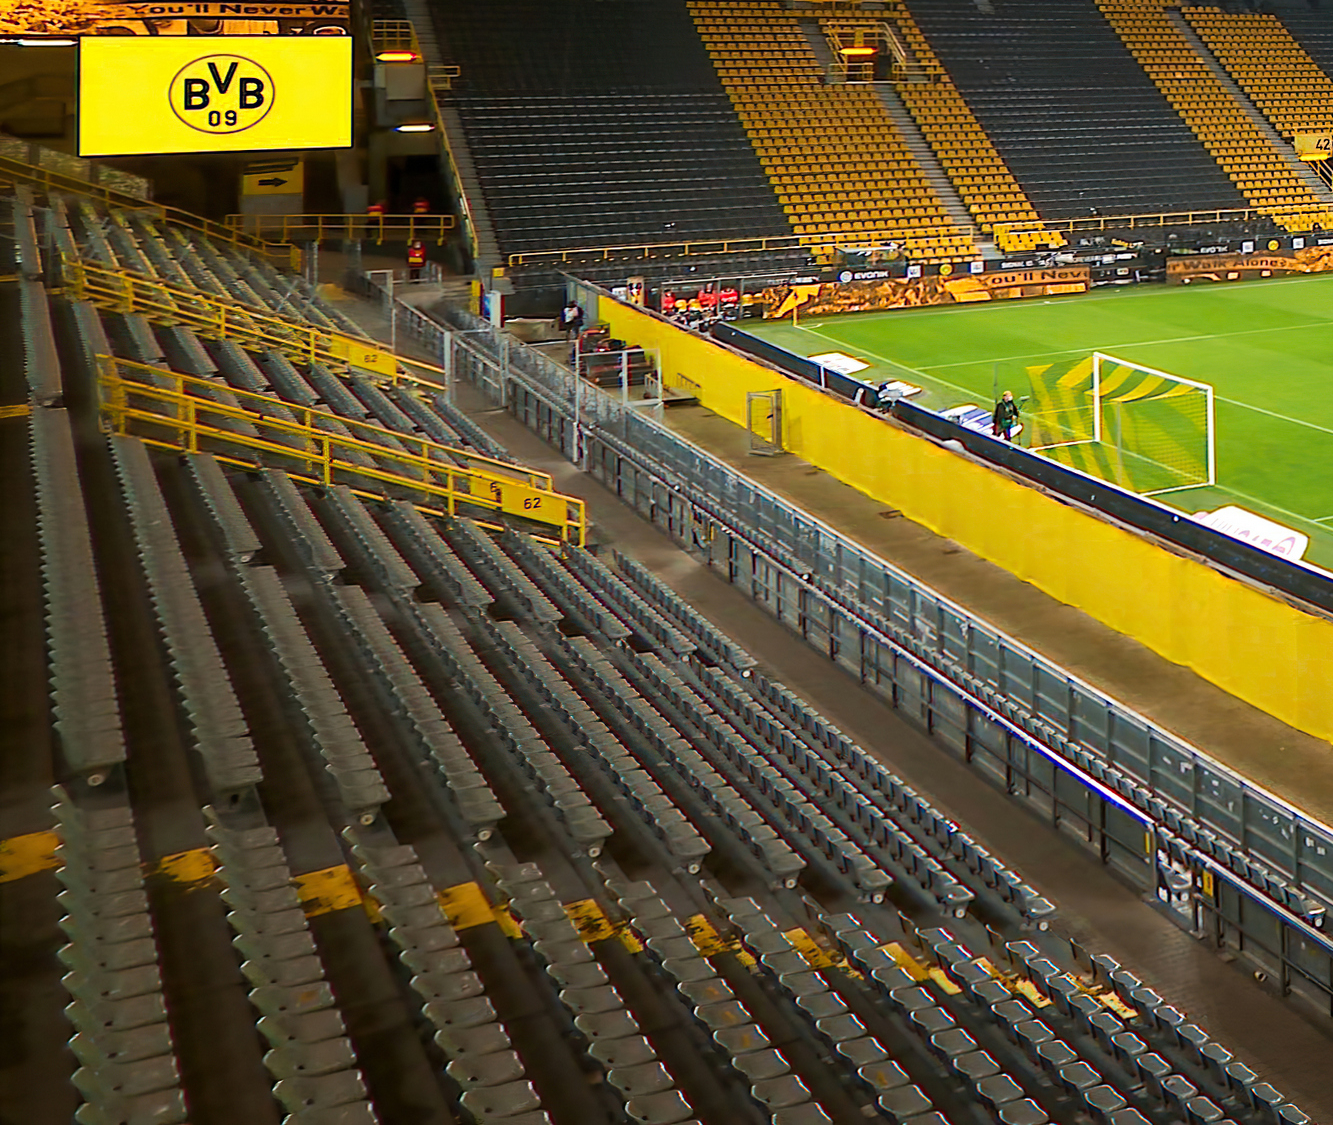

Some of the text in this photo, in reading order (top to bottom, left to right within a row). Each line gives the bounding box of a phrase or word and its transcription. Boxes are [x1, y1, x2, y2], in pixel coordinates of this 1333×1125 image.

[128, 3, 208, 16] You'll
[219, 4, 299, 16] Never
[184, 62, 264, 110] BVB
[208, 110, 238, 126] 09
[1316, 138, 1331, 151] 42
[523, 497, 542, 510] 62
